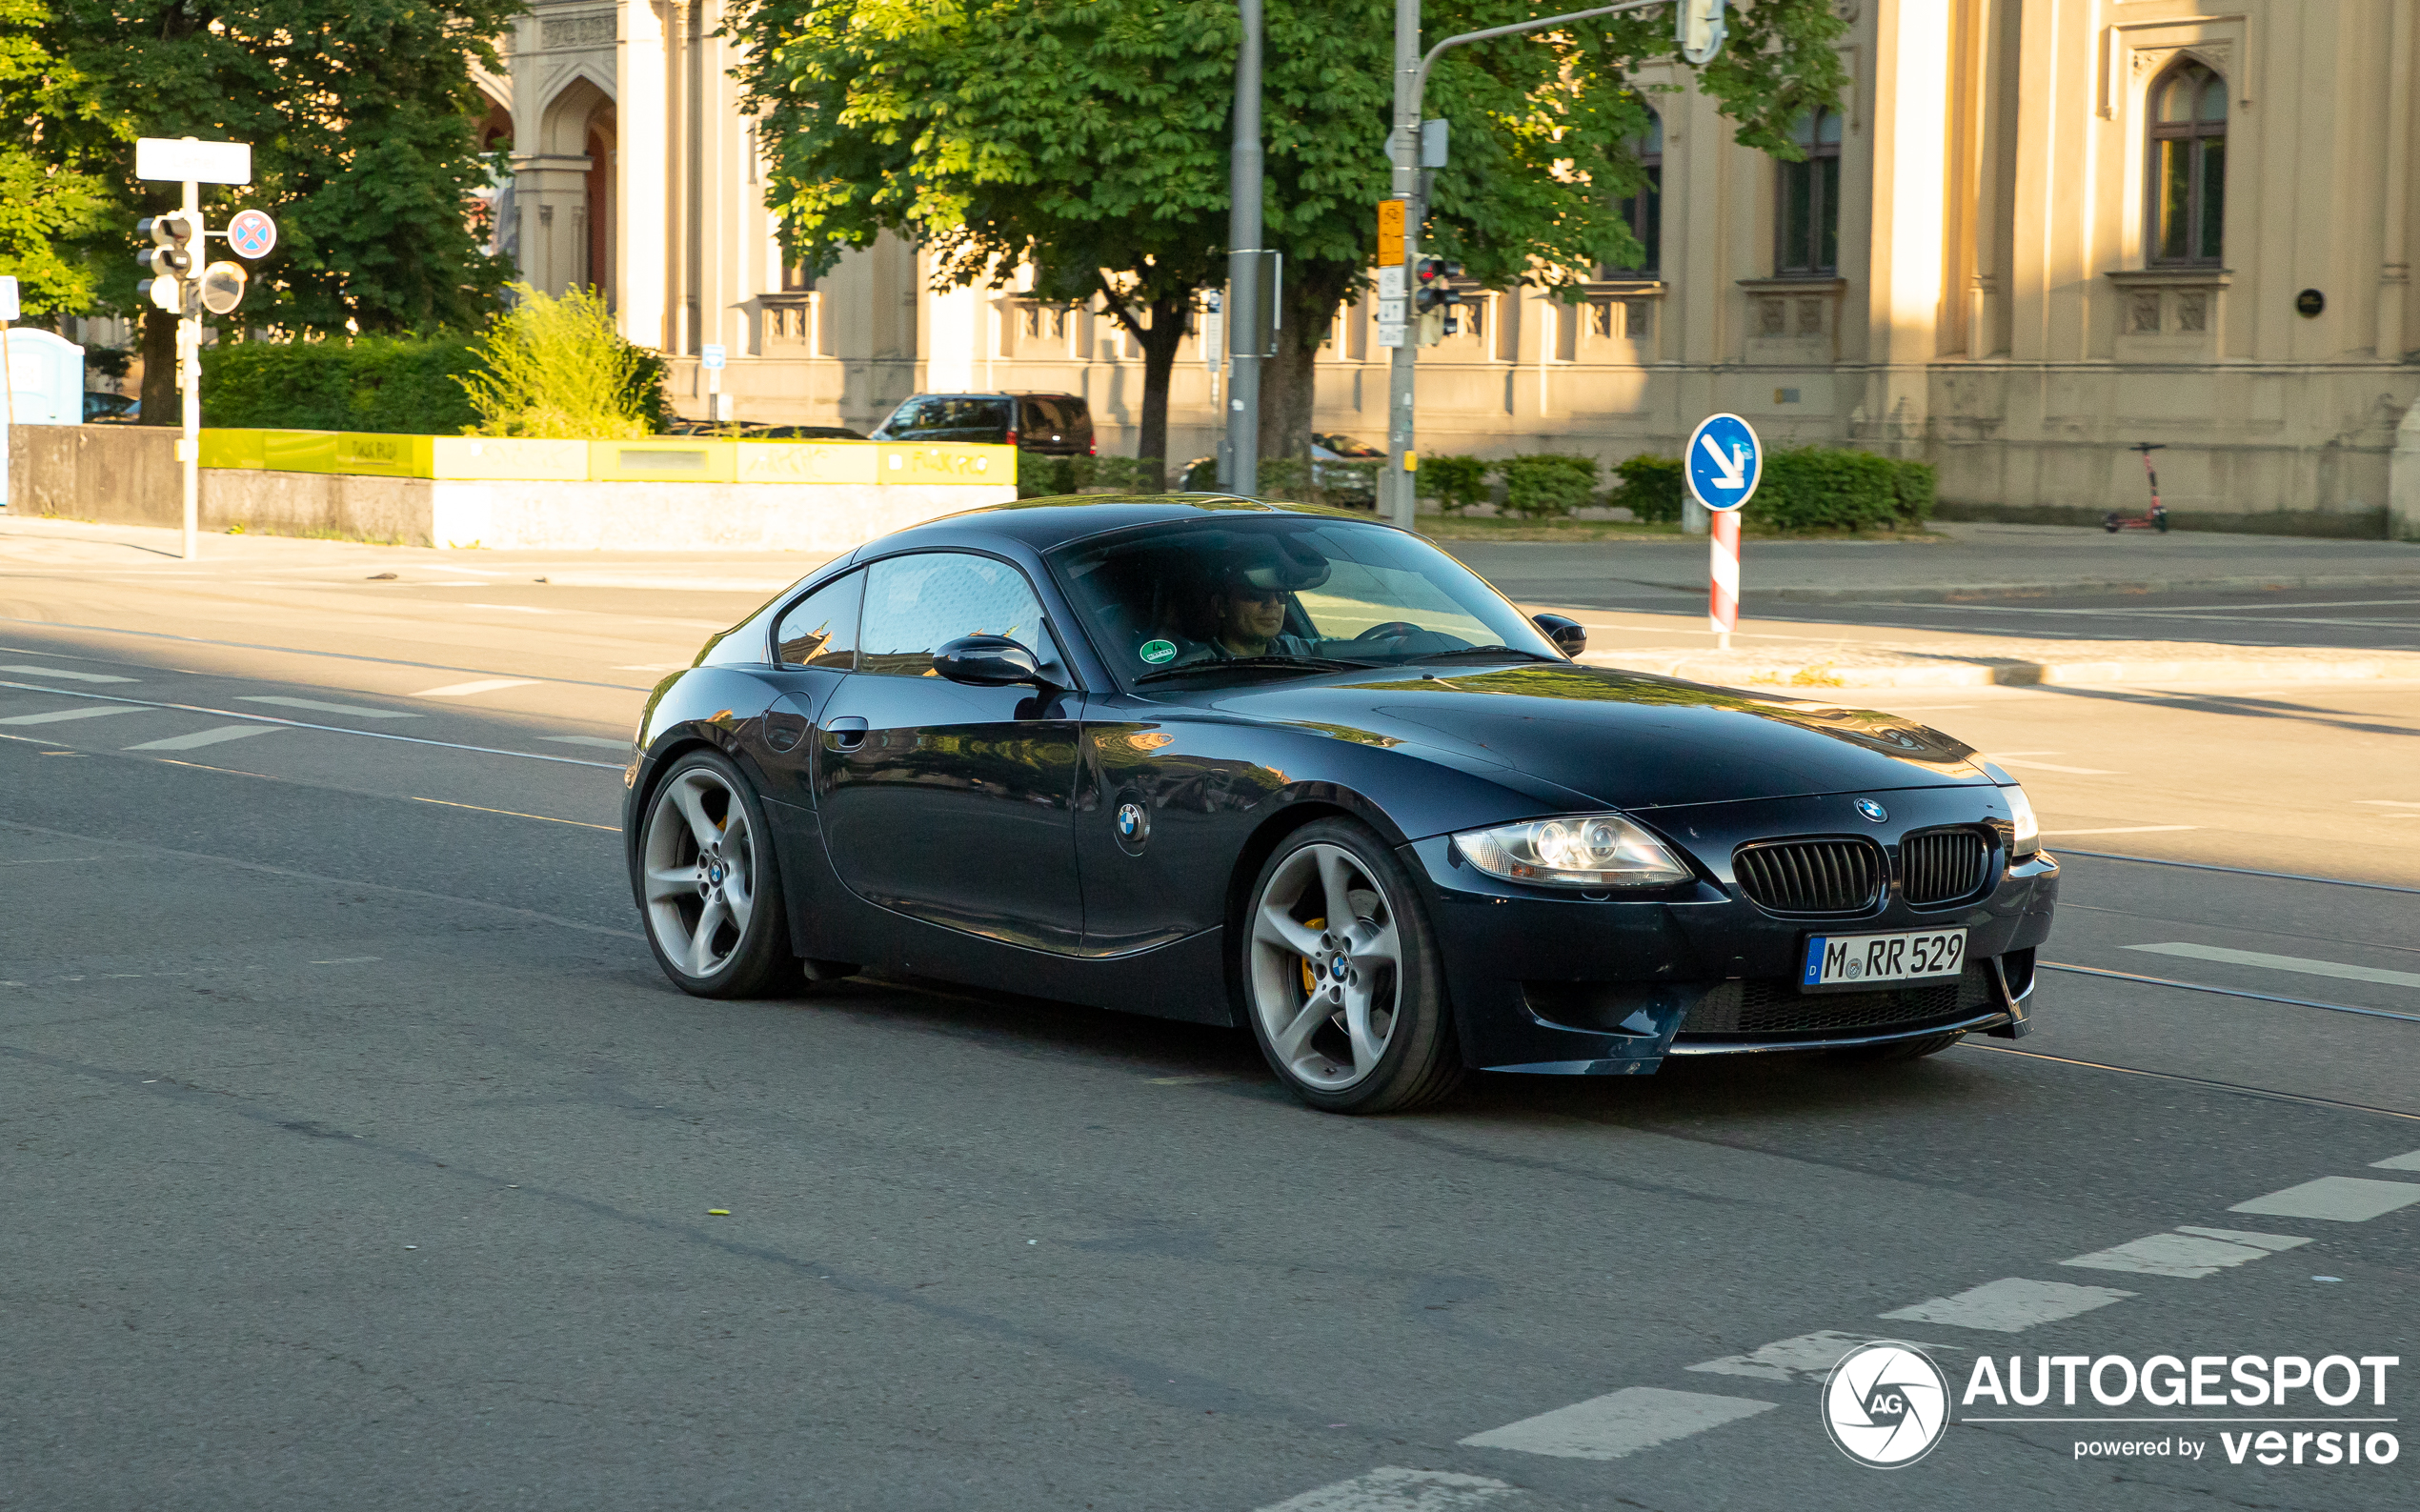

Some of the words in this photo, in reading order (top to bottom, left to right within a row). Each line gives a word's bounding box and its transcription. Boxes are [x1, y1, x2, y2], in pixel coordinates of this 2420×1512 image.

[1824, 941, 1847, 978] M
[1865, 938, 1906, 978] RR
[1910, 933, 1963, 974] 529
[1808, 965, 1817, 977] D
